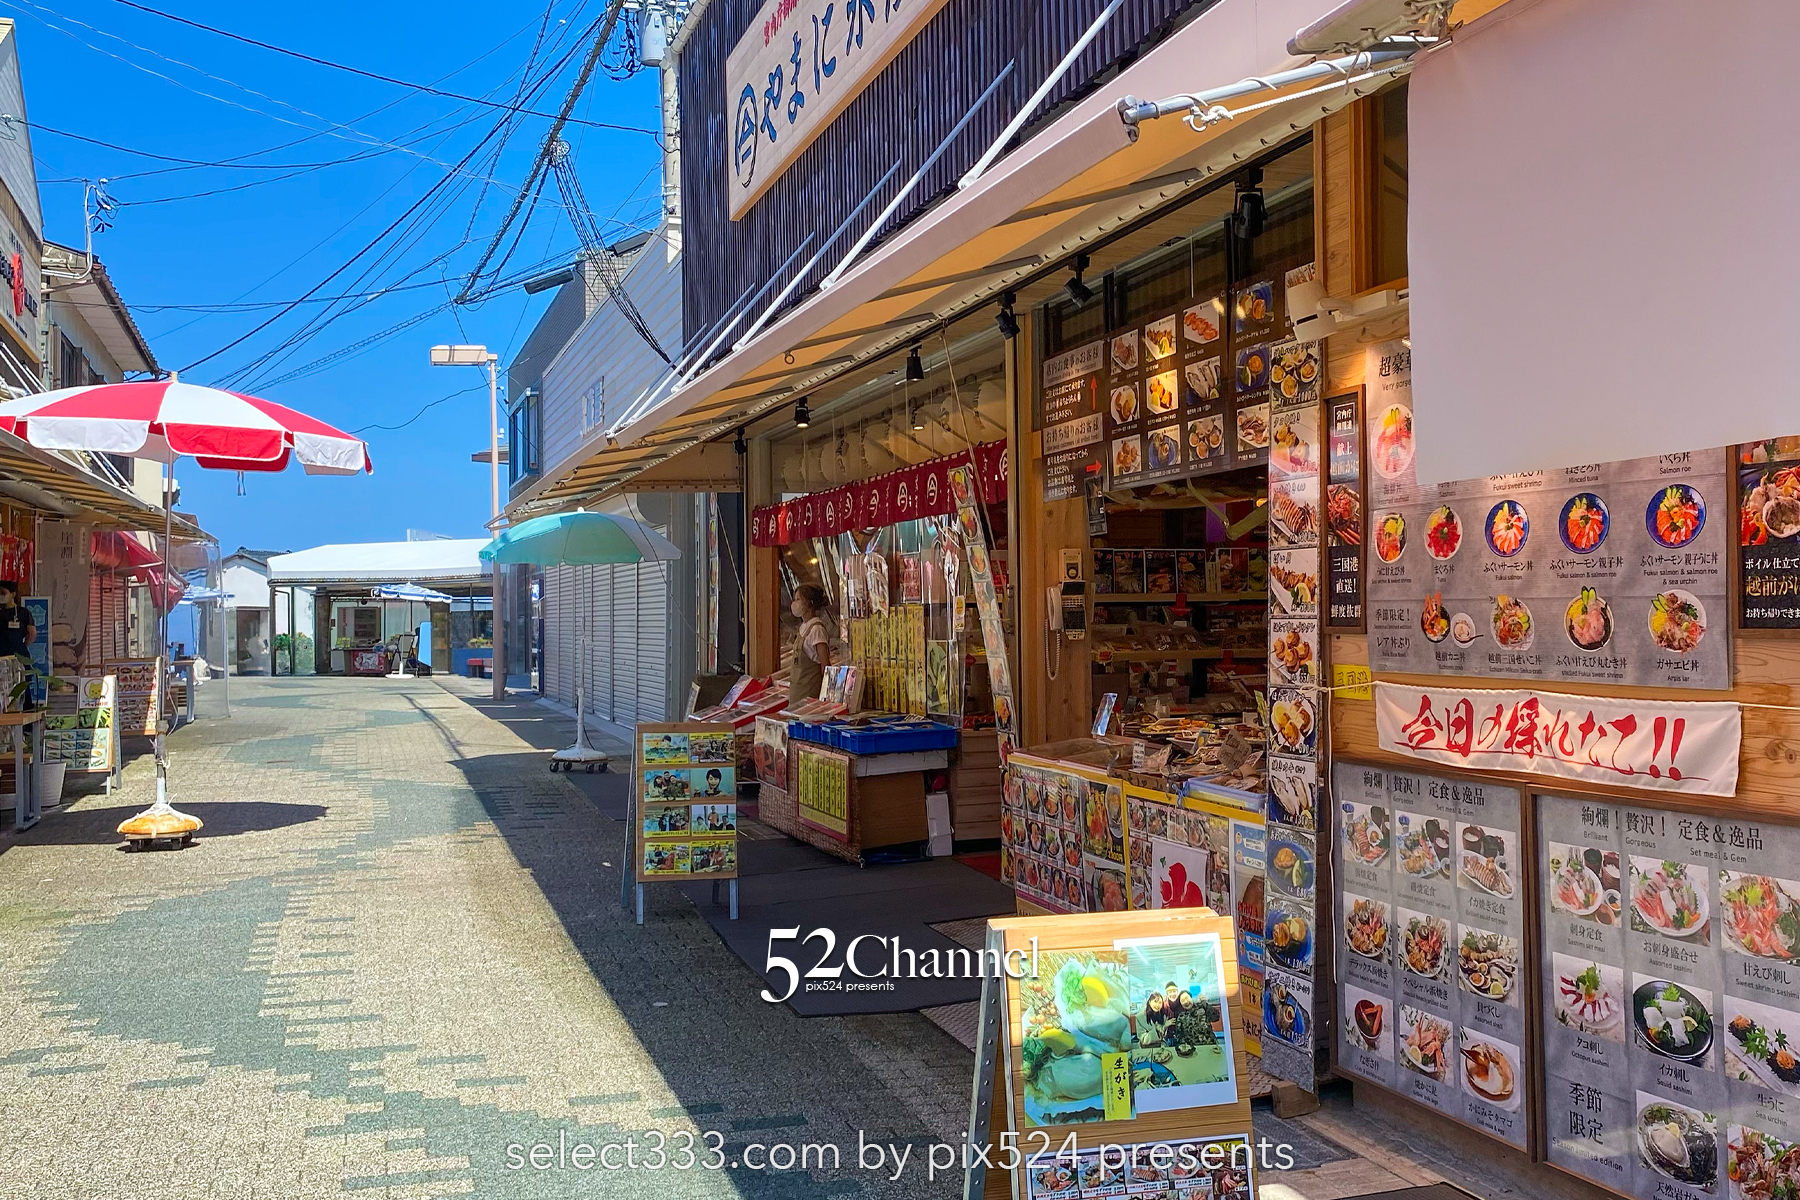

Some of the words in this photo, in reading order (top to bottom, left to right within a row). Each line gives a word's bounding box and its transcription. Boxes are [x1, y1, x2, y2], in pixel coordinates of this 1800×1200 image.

[1336, 441, 1353, 457] 献上
[1659, 452, 1691, 465] いくら丼
[1659, 466, 1679, 475] Salmon
[1680, 465, 1691, 473] roe
[1507, 482, 1523, 490] sweet
[1524, 480, 1542, 489] shrimp
[1333, 556, 1359, 572] 三国港
[1483, 560, 1534, 573] ふくいサーモン丼
[1640, 552, 1718, 566] ふくいサーモン親子うに丼
[1744, 556, 1800, 570] ボイル仕立て
[1434, 564, 1455, 575] まぐろ丼
[1336, 577, 1357, 593] 直送！
[1330, 604, 1361, 618] 鮮度抜群
[1375, 608, 1411, 621] 季節限定！
[1435, 651, 1466, 662] 越前カニ丼
[1488, 652, 1543, 665] 越前三国せいこ丼
[1556, 655, 1627, 670] ふくい甘えび丸むき丼
[1656, 659, 1700, 672] ガサエビ丼
[1336, 670, 1370, 695] 三国港
[1606, 671, 1624, 679] shrimp
[1393, 795, 1414, 806] Gorgeous
[1436, 803, 1444, 811] Set
[1445, 805, 1457, 813] meal
[1463, 808, 1474, 817] Gem
[1583, 830, 1608, 842] Brilliant
[1625, 836, 1656, 849] Gorgeous
[1690, 847, 1702, 857] Set
[1703, 849, 1721, 861] meal
[1730, 852, 1747, 864] Gem
[1468, 896, 1506, 916] イカ焼き定食
[1570, 923, 1603, 943] 刺身定食
[1567, 938, 1586, 949] Sashimi
[1594, 943, 1606, 953] meal
[1643, 940, 1699, 964] お刺身盛合せ
[1348, 958, 1388, 980] デラックス浜焼き
[1649, 958, 1672, 970] Assorted
[1672, 962, 1693, 974] sashimi
[1743, 961, 1792, 985] 甘えび刺し
[1403, 977, 1448, 1000] スペシャル浜焼き
[1735, 977, 1754, 990] Sweet
[1754, 980, 1775, 994] shrimp
[1775, 985, 1800, 1000] sashimi
[1477, 1001, 1500, 1019] 貝づくし
[1474, 1015, 1492, 1027] Assorted
[1576, 1035, 1604, 1055] タコ刺し
[1359, 1054, 1379, 1071] なぎさ汁
[1571, 1050, 1591, 1063] Octopus
[1591, 1055, 1610, 1068] sashimi
[1113, 1056, 1127, 1101] 生がき
[1659, 1062, 1690, 1083] イカ刺し
[1656, 1077, 1671, 1090] Squid
[1672, 1082, 1693, 1096] sashimi
[1569, 1081, 1603, 1114] 季節
[1757, 1093, 1785, 1113] 生うに
[1468, 1102, 1513, 1128] かにみそタマゴ
[1755, 1110, 1767, 1121] Sea
[1767, 1112, 1789, 1127] urchin
[1569, 1109, 1604, 1146] 限定
[1574, 1143, 1598, 1161] limited
[1599, 1154, 1623, 1172] edition
